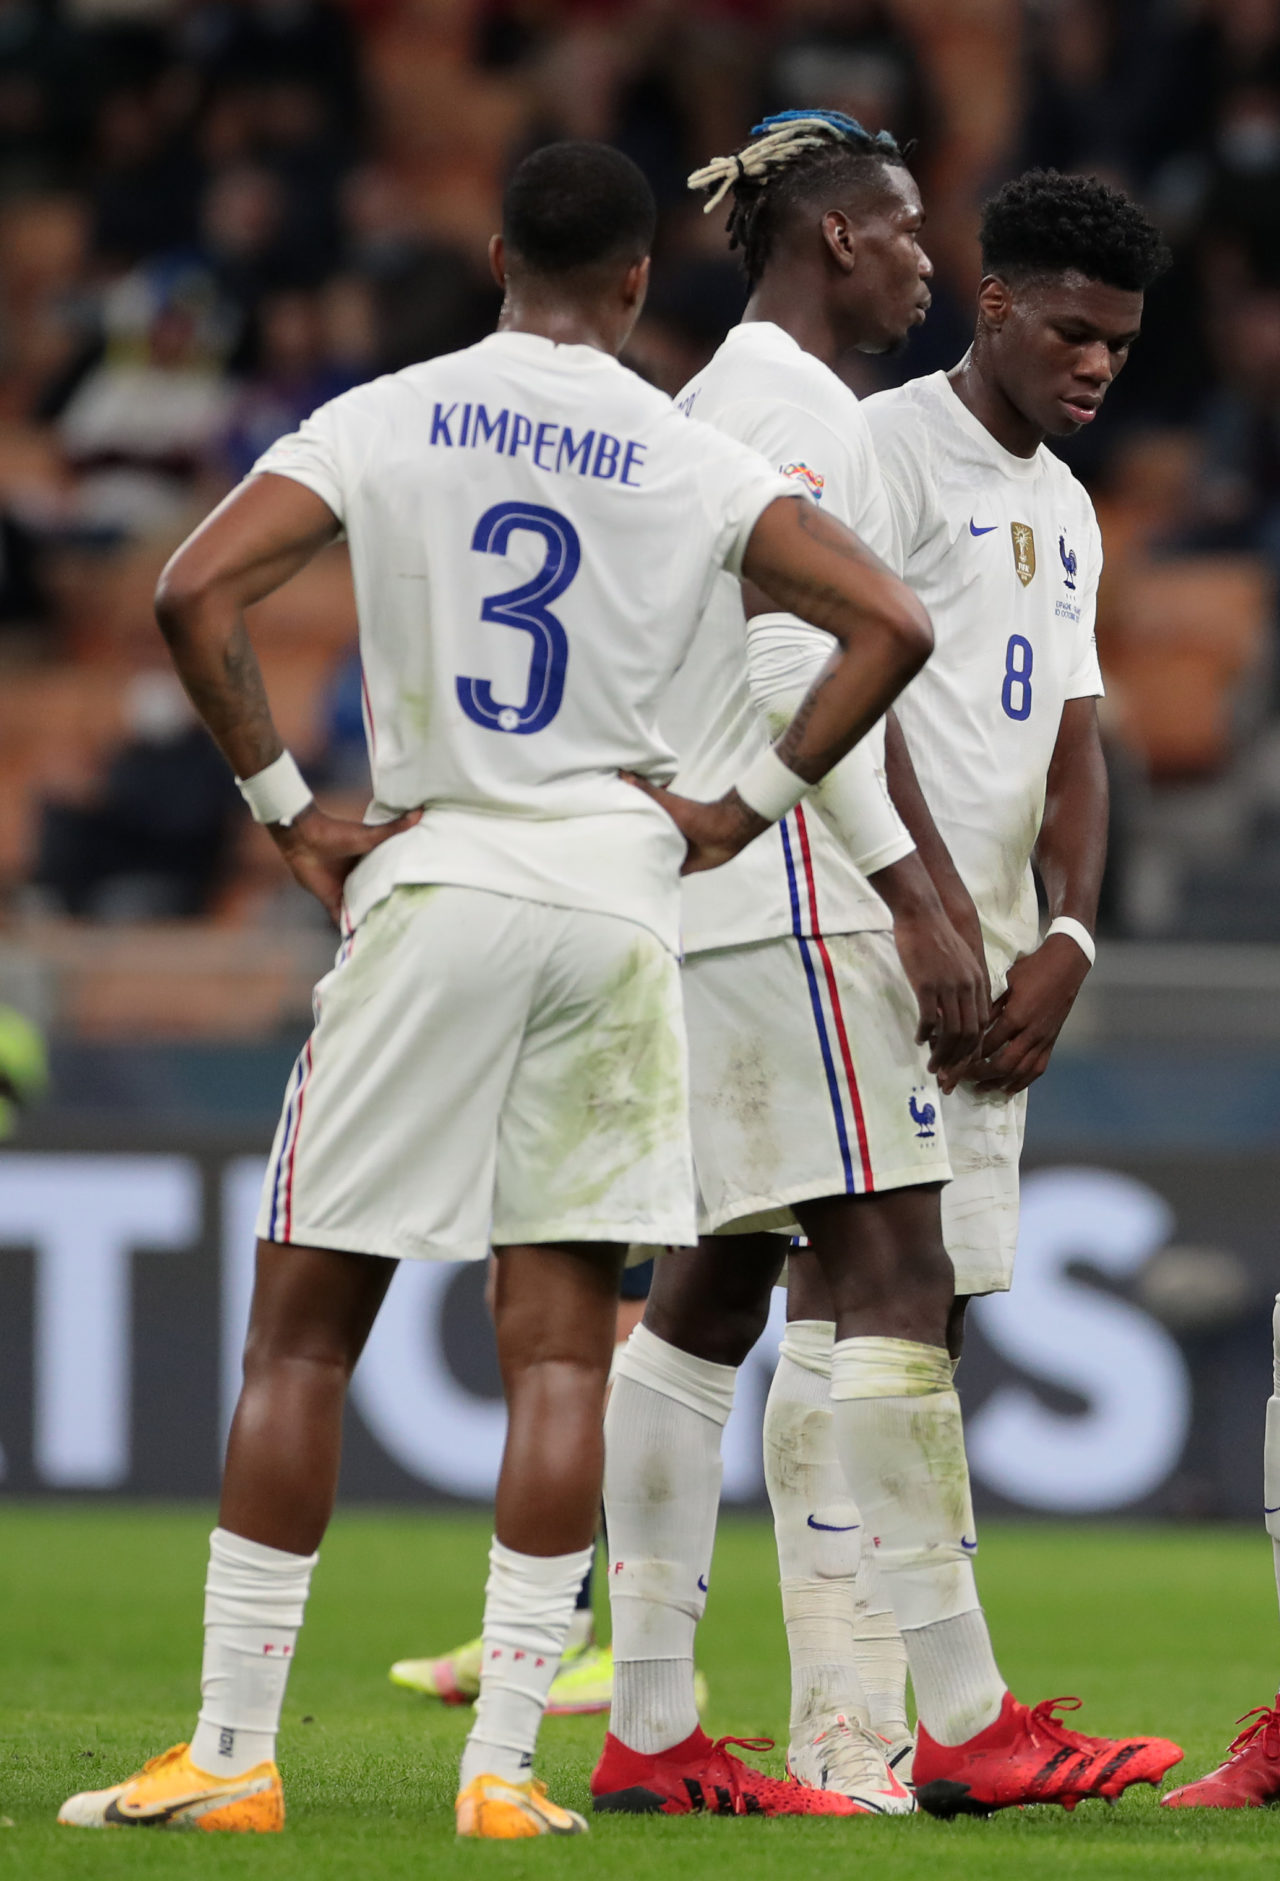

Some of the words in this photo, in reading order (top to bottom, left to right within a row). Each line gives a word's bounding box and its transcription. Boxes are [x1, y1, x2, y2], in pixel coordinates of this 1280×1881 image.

[429, 402, 648, 488] KIMPEMBE
[454, 500, 582, 735] 3
[1000, 633, 1034, 722] 8
